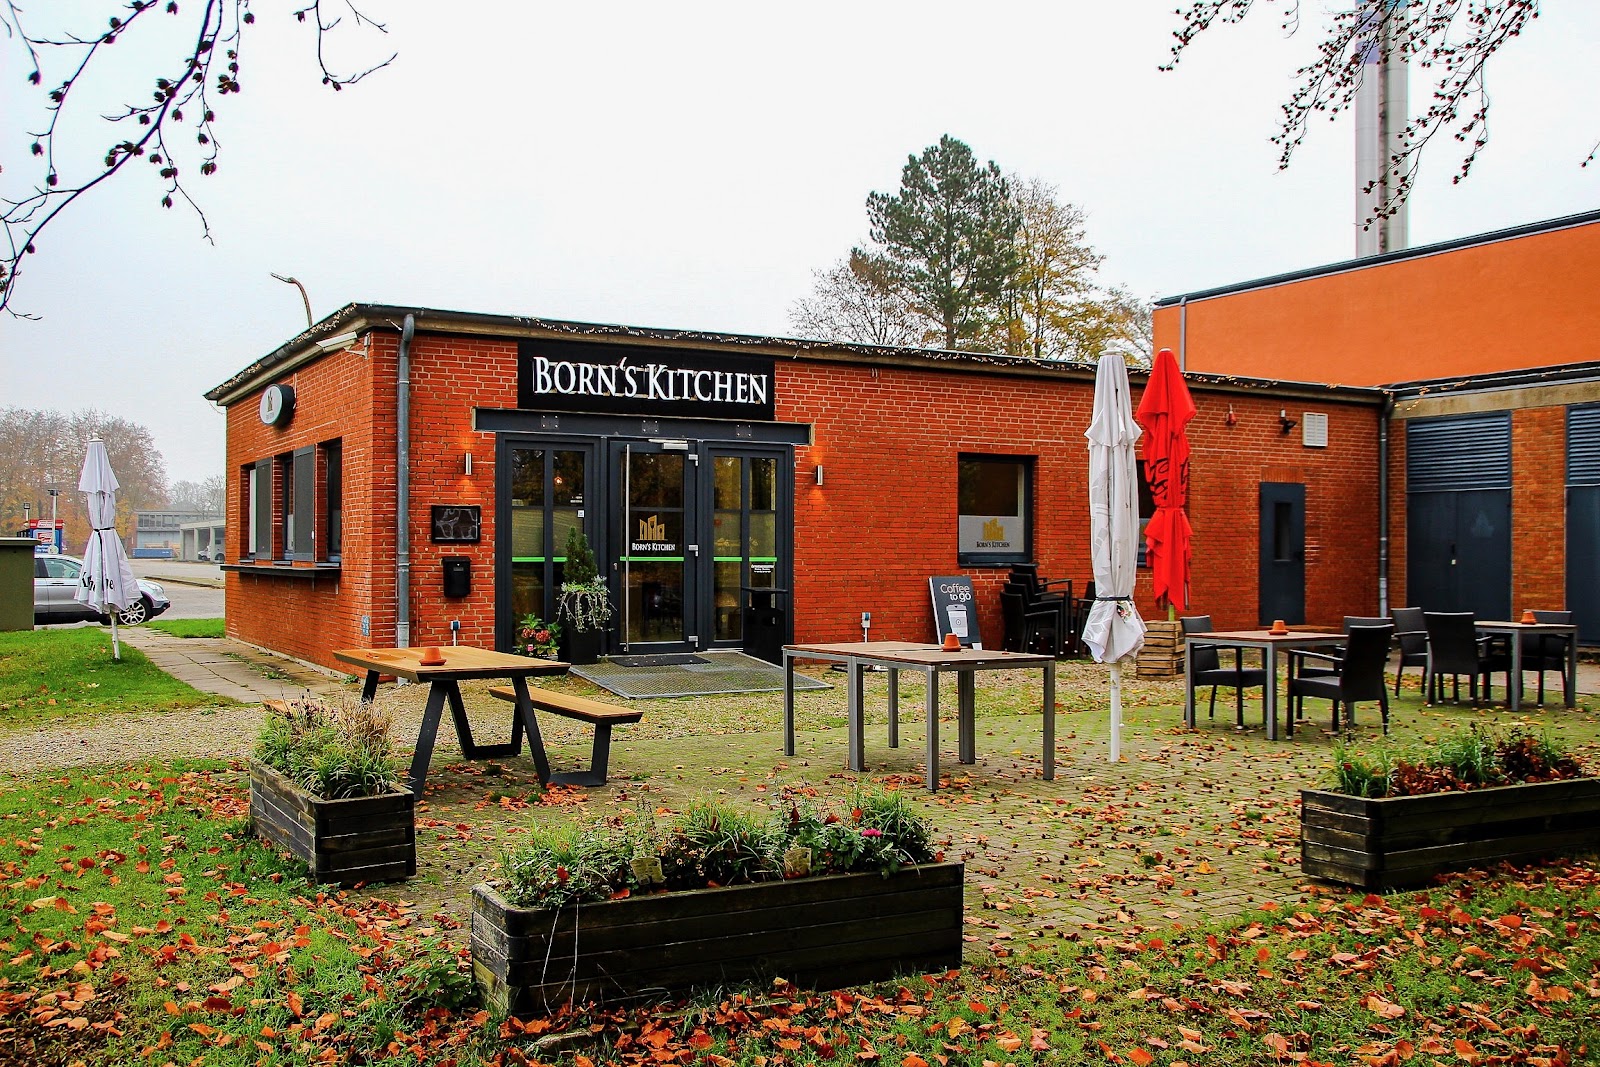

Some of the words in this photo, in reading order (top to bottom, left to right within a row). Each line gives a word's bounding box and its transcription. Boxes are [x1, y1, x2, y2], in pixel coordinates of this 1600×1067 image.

[647, 363, 768, 405] KITCHEN
[652, 542, 675, 551] KITCHEN
[940, 584, 970, 593] Coffee
[959, 593, 971, 603] go
